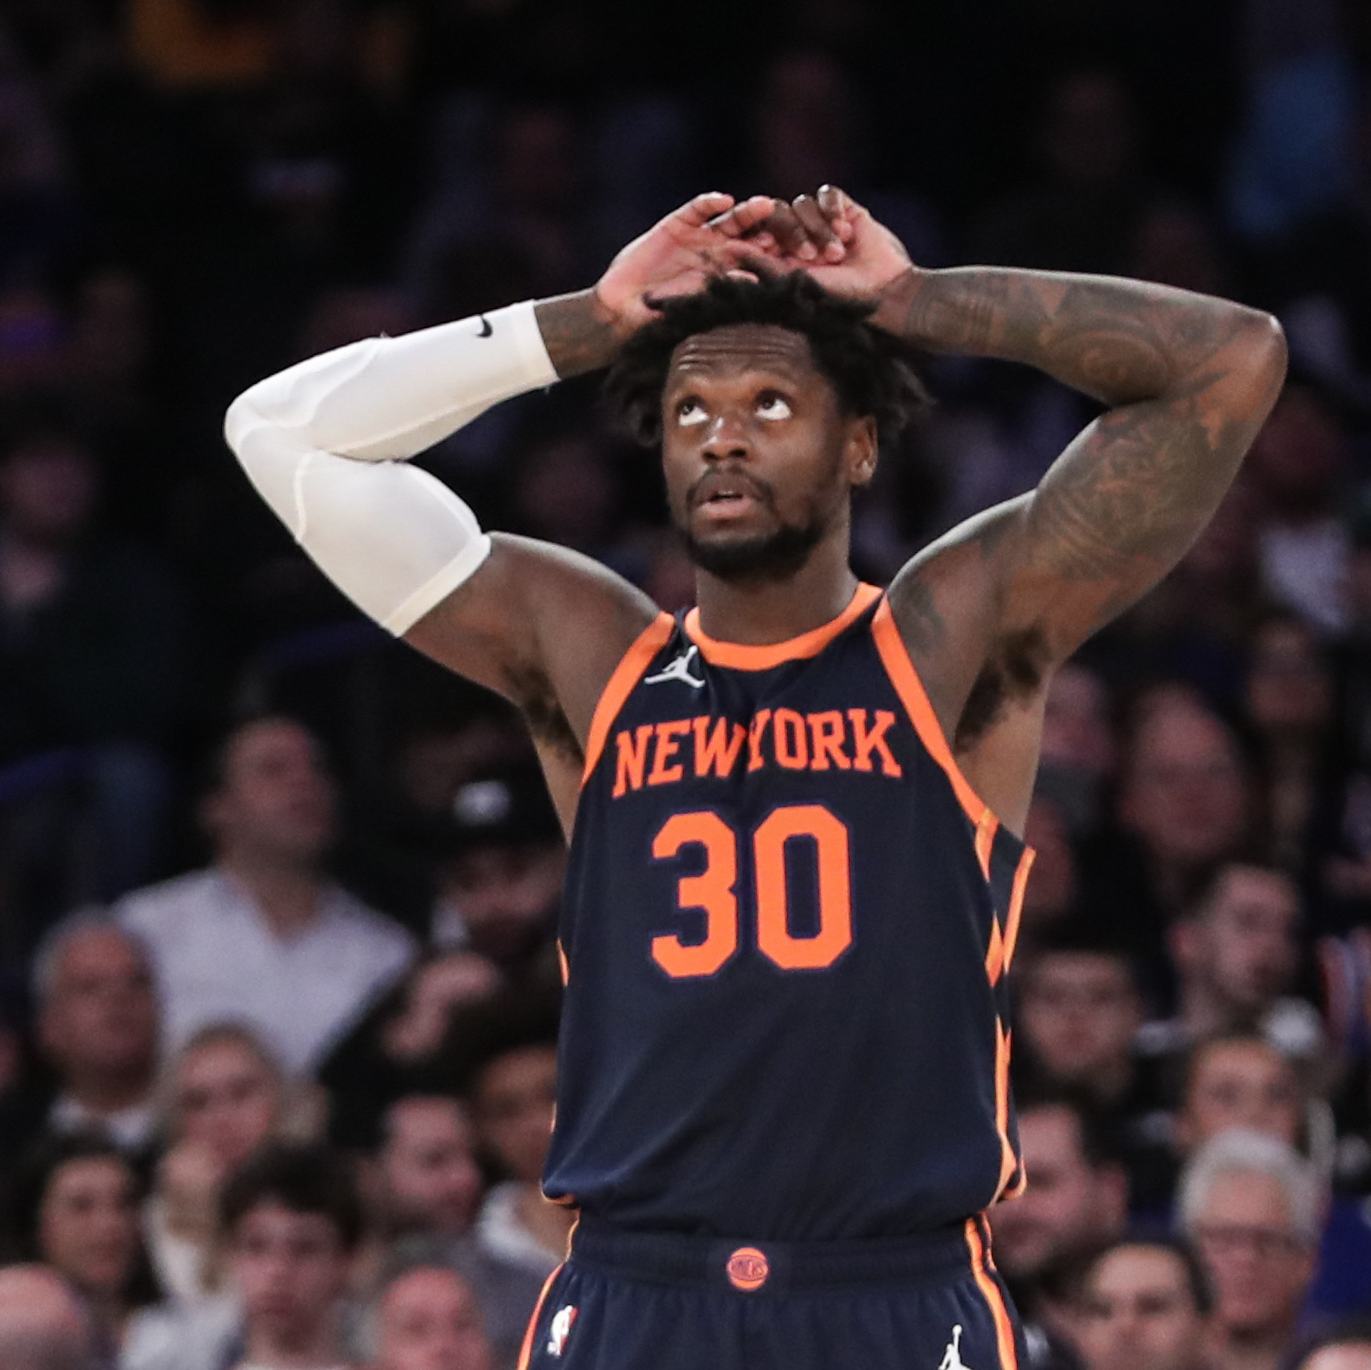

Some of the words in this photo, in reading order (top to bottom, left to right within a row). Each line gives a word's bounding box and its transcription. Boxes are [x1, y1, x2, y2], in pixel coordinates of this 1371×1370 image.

[611, 714, 747, 800] NEW
[747, 707, 903, 780] YORK
[650, 803, 854, 978] 30
